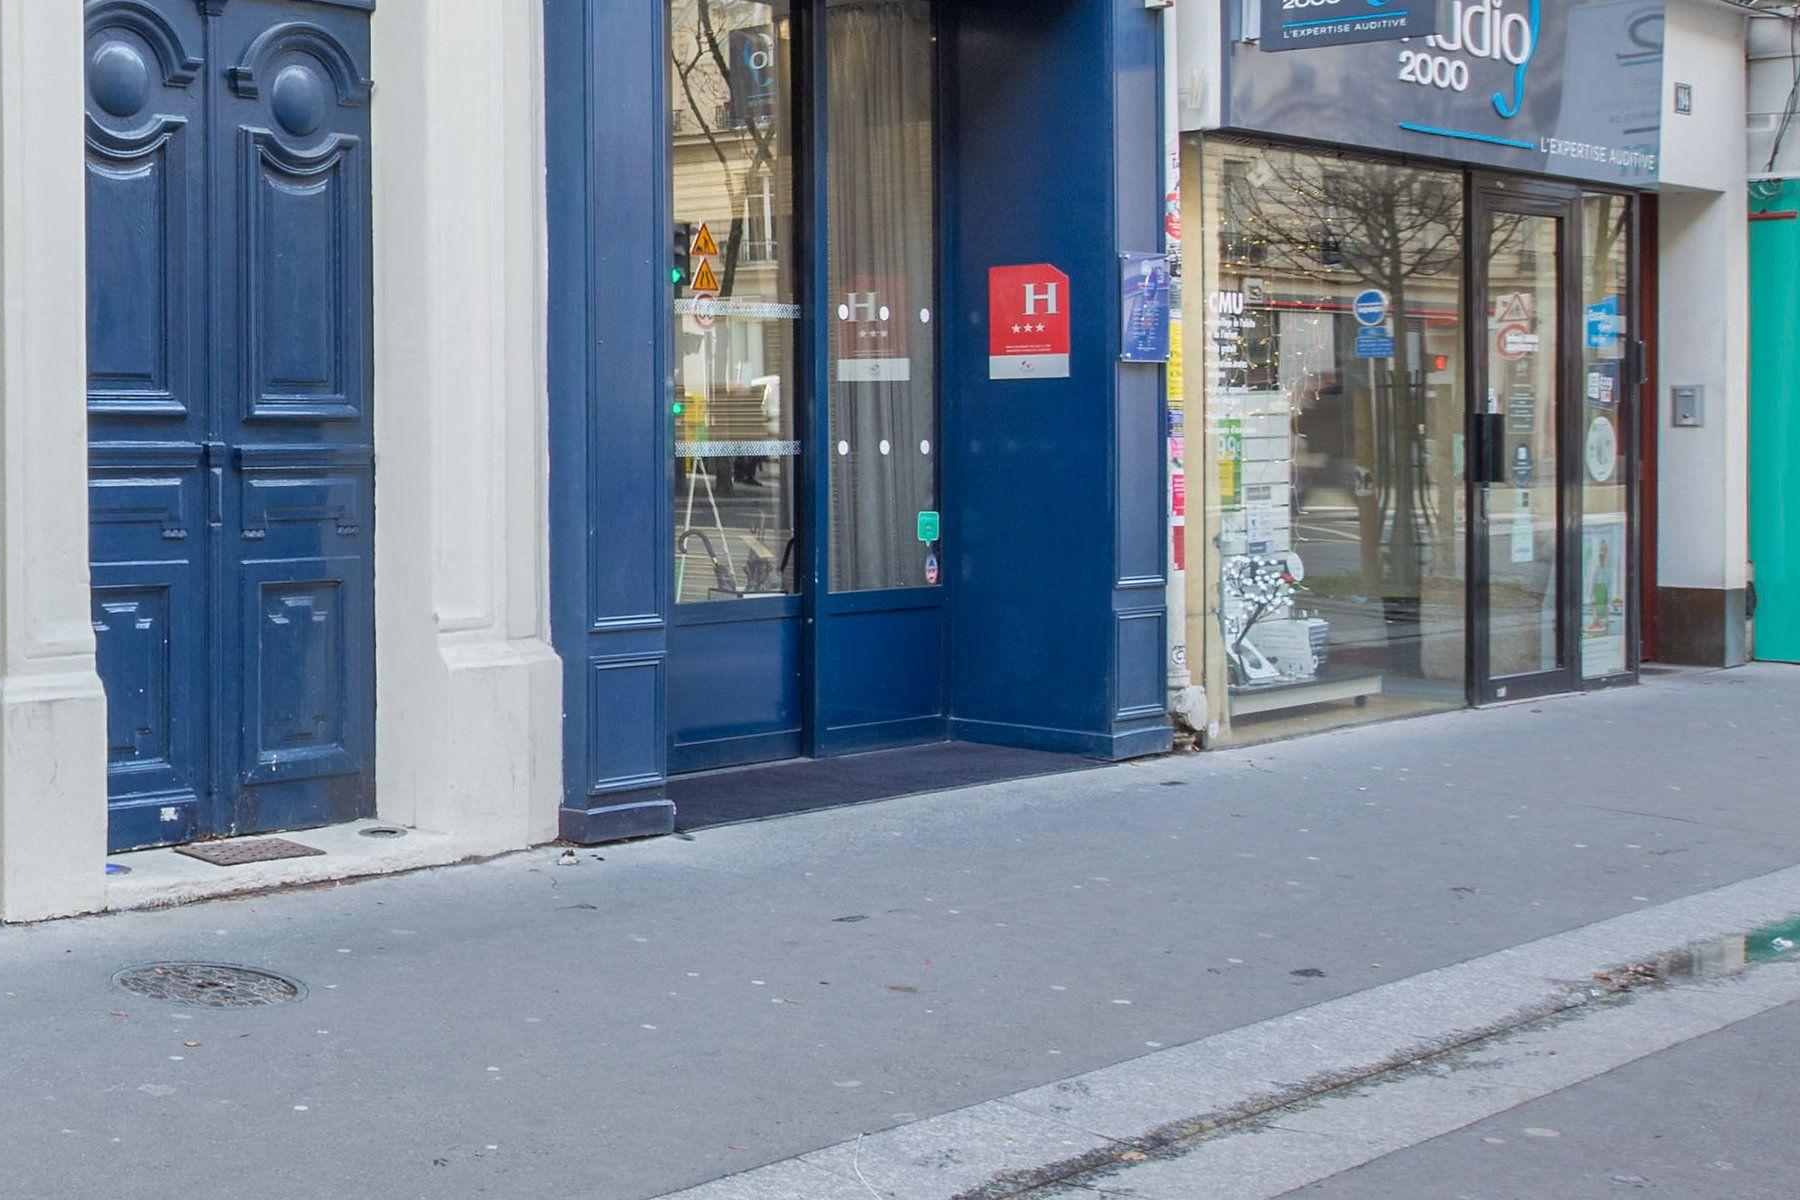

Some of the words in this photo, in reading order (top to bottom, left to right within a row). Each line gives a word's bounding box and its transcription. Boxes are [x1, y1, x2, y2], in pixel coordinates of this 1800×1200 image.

[1283, 23, 1351, 39] L'EXPERTISE
[1354, 18, 1407, 31] AUDITIVE
[1399, 50, 1468, 91] 2000
[1541, 136, 1607, 162] L'EXPERTISE
[1609, 148, 1656, 170] AUDITIVE
[1022, 282, 1060, 315] H
[1208, 291, 1244, 315] CMU
